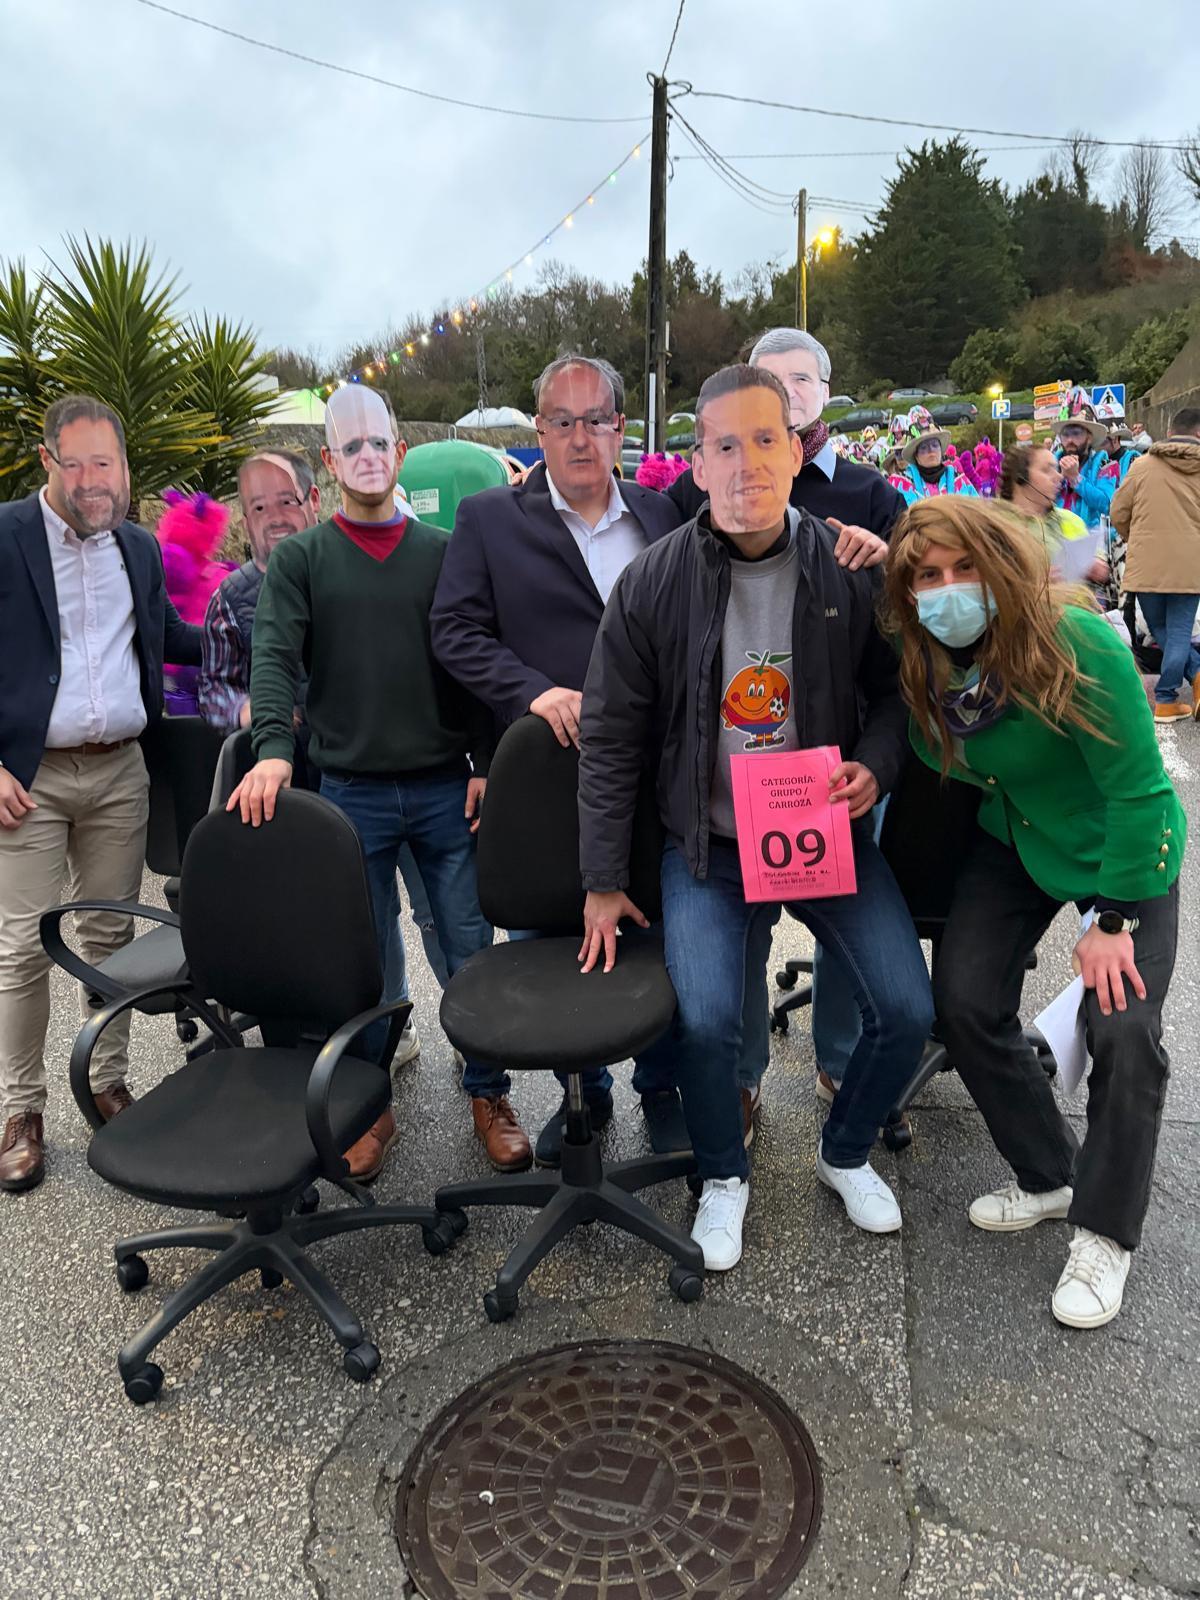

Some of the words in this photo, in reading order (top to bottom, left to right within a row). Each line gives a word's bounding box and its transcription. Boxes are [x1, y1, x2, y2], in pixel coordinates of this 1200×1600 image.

[996, 402, 1007, 417] P
[761, 774, 816, 787] CATEGORÍA:
[770, 788, 802, 798] GRUPO
[768, 798, 812, 810] CARROZA
[761, 829, 826, 869] 09
